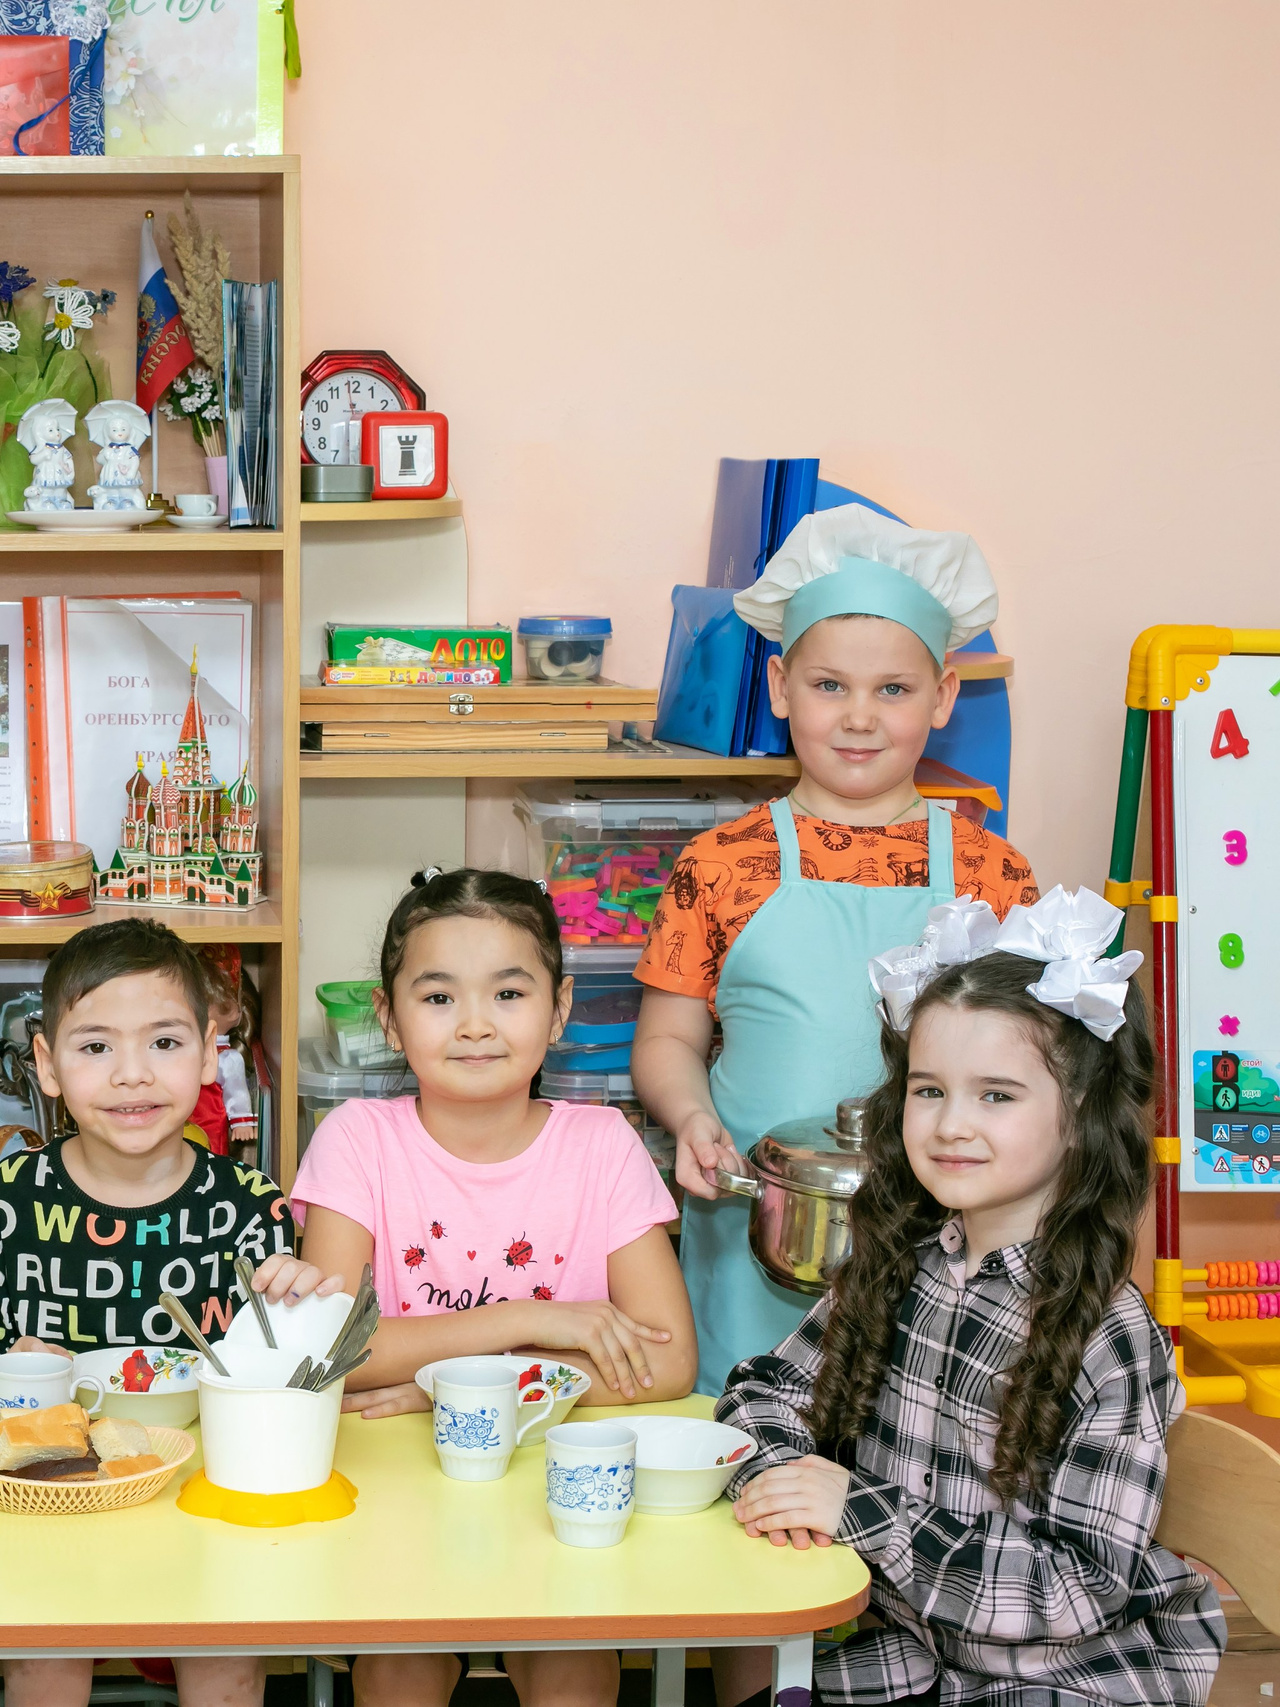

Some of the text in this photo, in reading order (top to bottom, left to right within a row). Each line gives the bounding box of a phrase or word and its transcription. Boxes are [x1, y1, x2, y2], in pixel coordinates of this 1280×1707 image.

[328, 386, 340, 400] 11
[345, 380, 361, 394] 12
[368, 386, 375, 399] 1
[315, 400, 329, 413] 10
[380, 399, 389, 411] 2
[312, 417, 321, 431] 9
[318, 436, 327, 450] 8
[330, 449, 340, 463] 7
[429, 638, 506, 664] ЛОТО
[107, 675, 150, 688] БОГА
[85, 713, 230, 726] ОРЕНБУРГСГО
[1210, 708, 1250, 759] 4
[1222, 829, 1248, 866] 3
[1218, 932, 1245, 969] 8
[33, 1201, 237, 1246] WORLD
